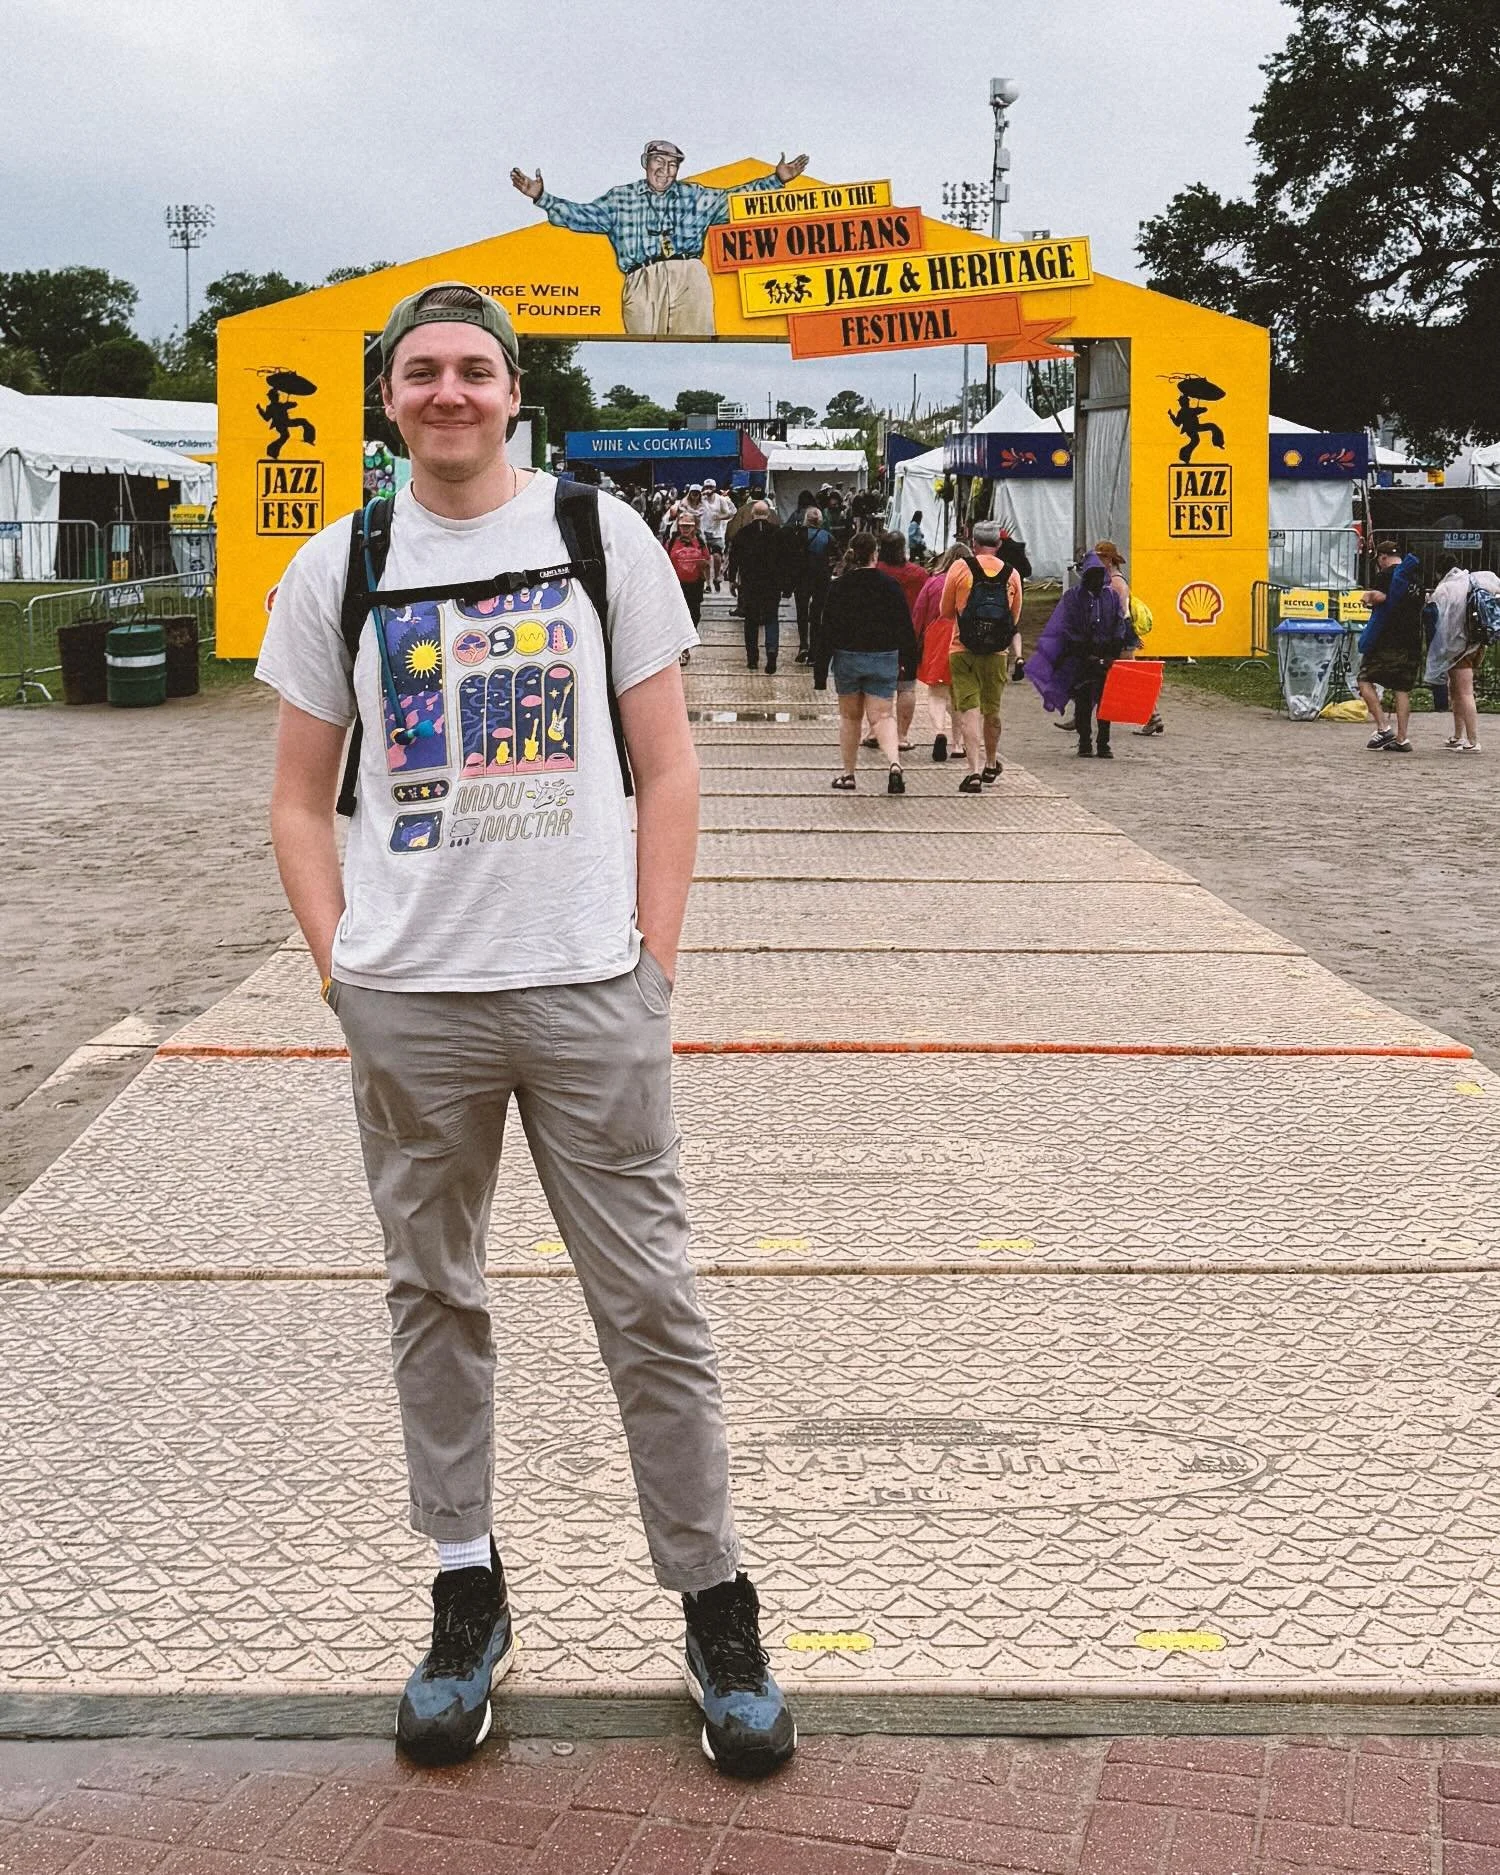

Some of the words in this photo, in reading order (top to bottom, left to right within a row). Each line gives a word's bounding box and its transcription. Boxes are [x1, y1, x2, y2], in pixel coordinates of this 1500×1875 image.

[744, 191, 819, 216] WELCOME
[822, 189, 842, 208] TO
[845, 185, 877, 206] THE
[722, 227, 779, 262] NEW
[786, 215, 911, 256] ORLEANS
[824, 262, 893, 306] JAZZ
[899, 261, 921, 293] &
[928, 243, 1076, 292] HERITAGE
[472, 285, 526, 297] ORGE
[841, 308, 957, 347] FESTIVAL
[592, 439, 623, 451] WINE
[627, 440, 639, 451] &
[643, 437, 712, 451] COCKTAILS
[261, 467, 318, 498] JAZZ
[1173, 470, 1227, 501] JAZZ
[262, 502, 319, 529] FEST
[1174, 504, 1228, 531] FEST
[452, 781, 526, 815] MDOU
[479, 808, 574, 843] MOCTAR
[727, 1448, 1121, 1476] DURA-BAS
